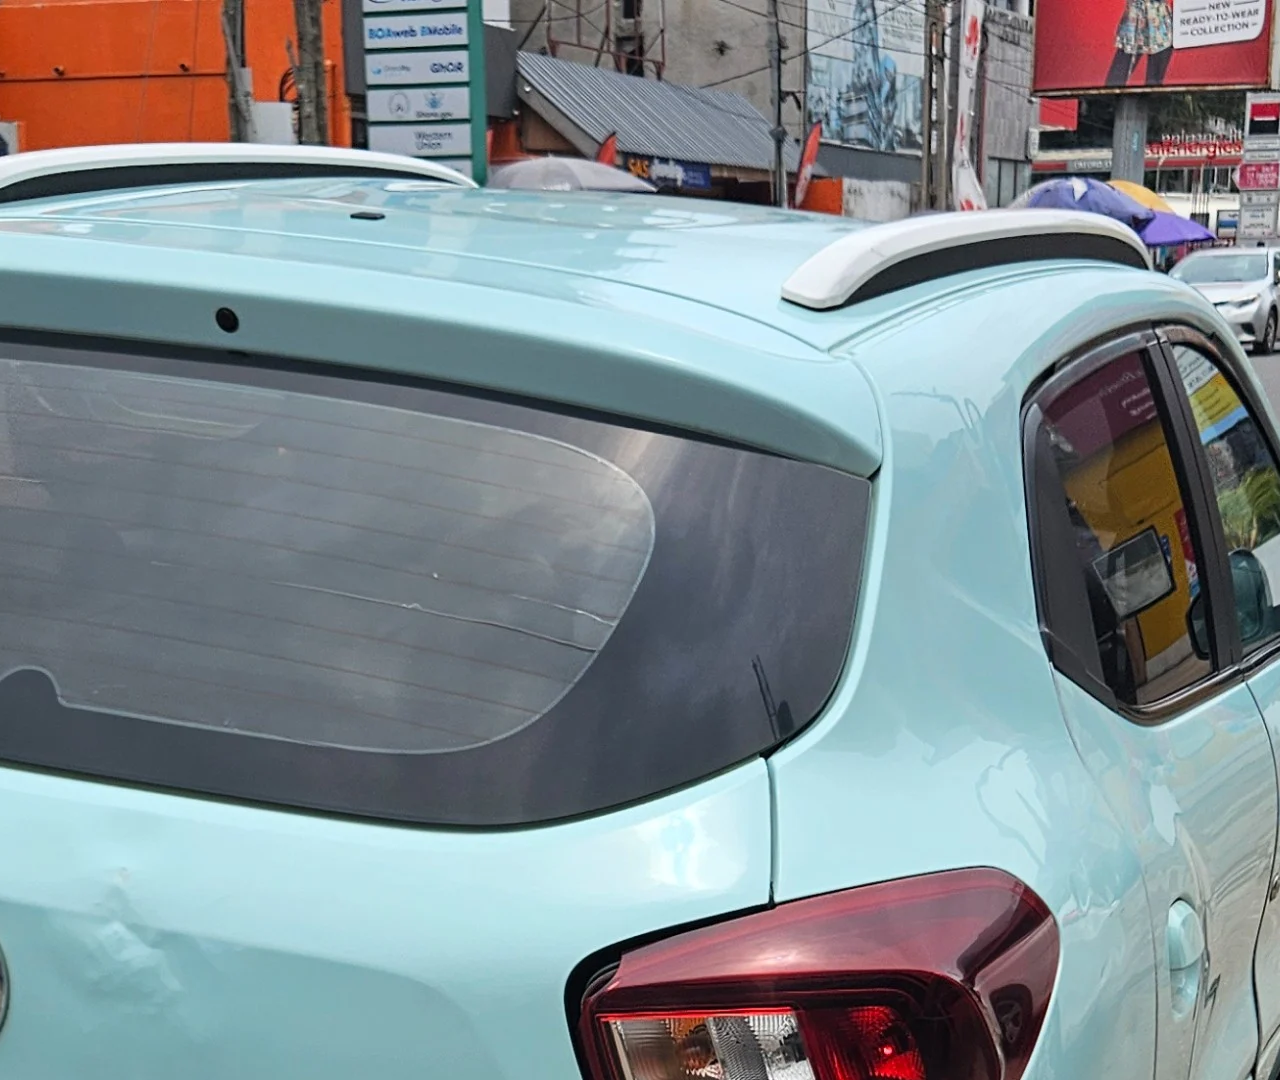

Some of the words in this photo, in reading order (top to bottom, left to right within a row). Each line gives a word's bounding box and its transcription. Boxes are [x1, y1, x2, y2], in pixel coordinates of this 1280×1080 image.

[1208, 2, 1231, 11] NEW
[1179, 8, 1260, 26] READY-TO-WEAR
[1190, 22, 1250, 37] COLLECTION
